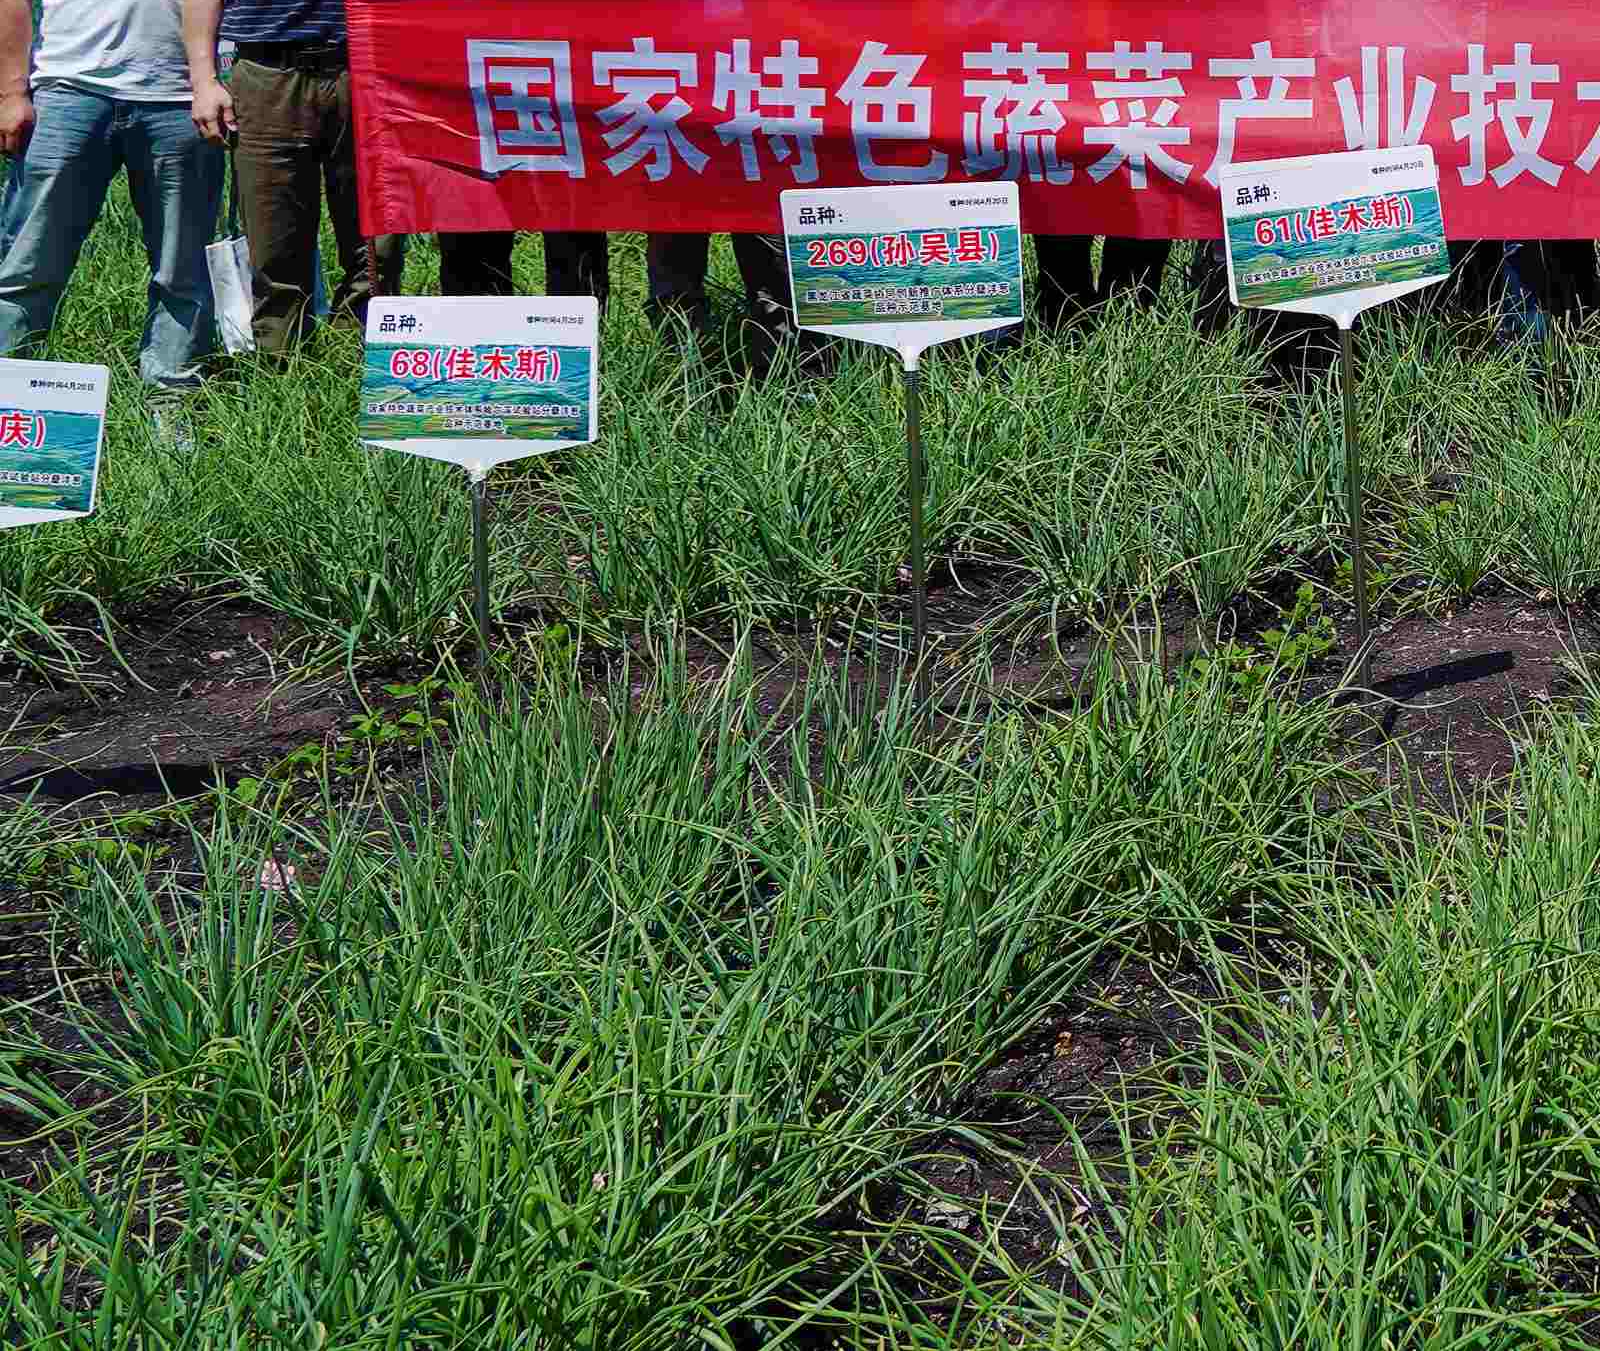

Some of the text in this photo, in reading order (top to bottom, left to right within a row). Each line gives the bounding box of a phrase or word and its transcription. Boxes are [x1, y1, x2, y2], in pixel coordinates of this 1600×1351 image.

[1255, 194, 1415, 246] 61(佳木斯)
[807, 230, 1000, 267] 269(孙吴县)
[390, 347, 561, 383] 68(佳木斯)
